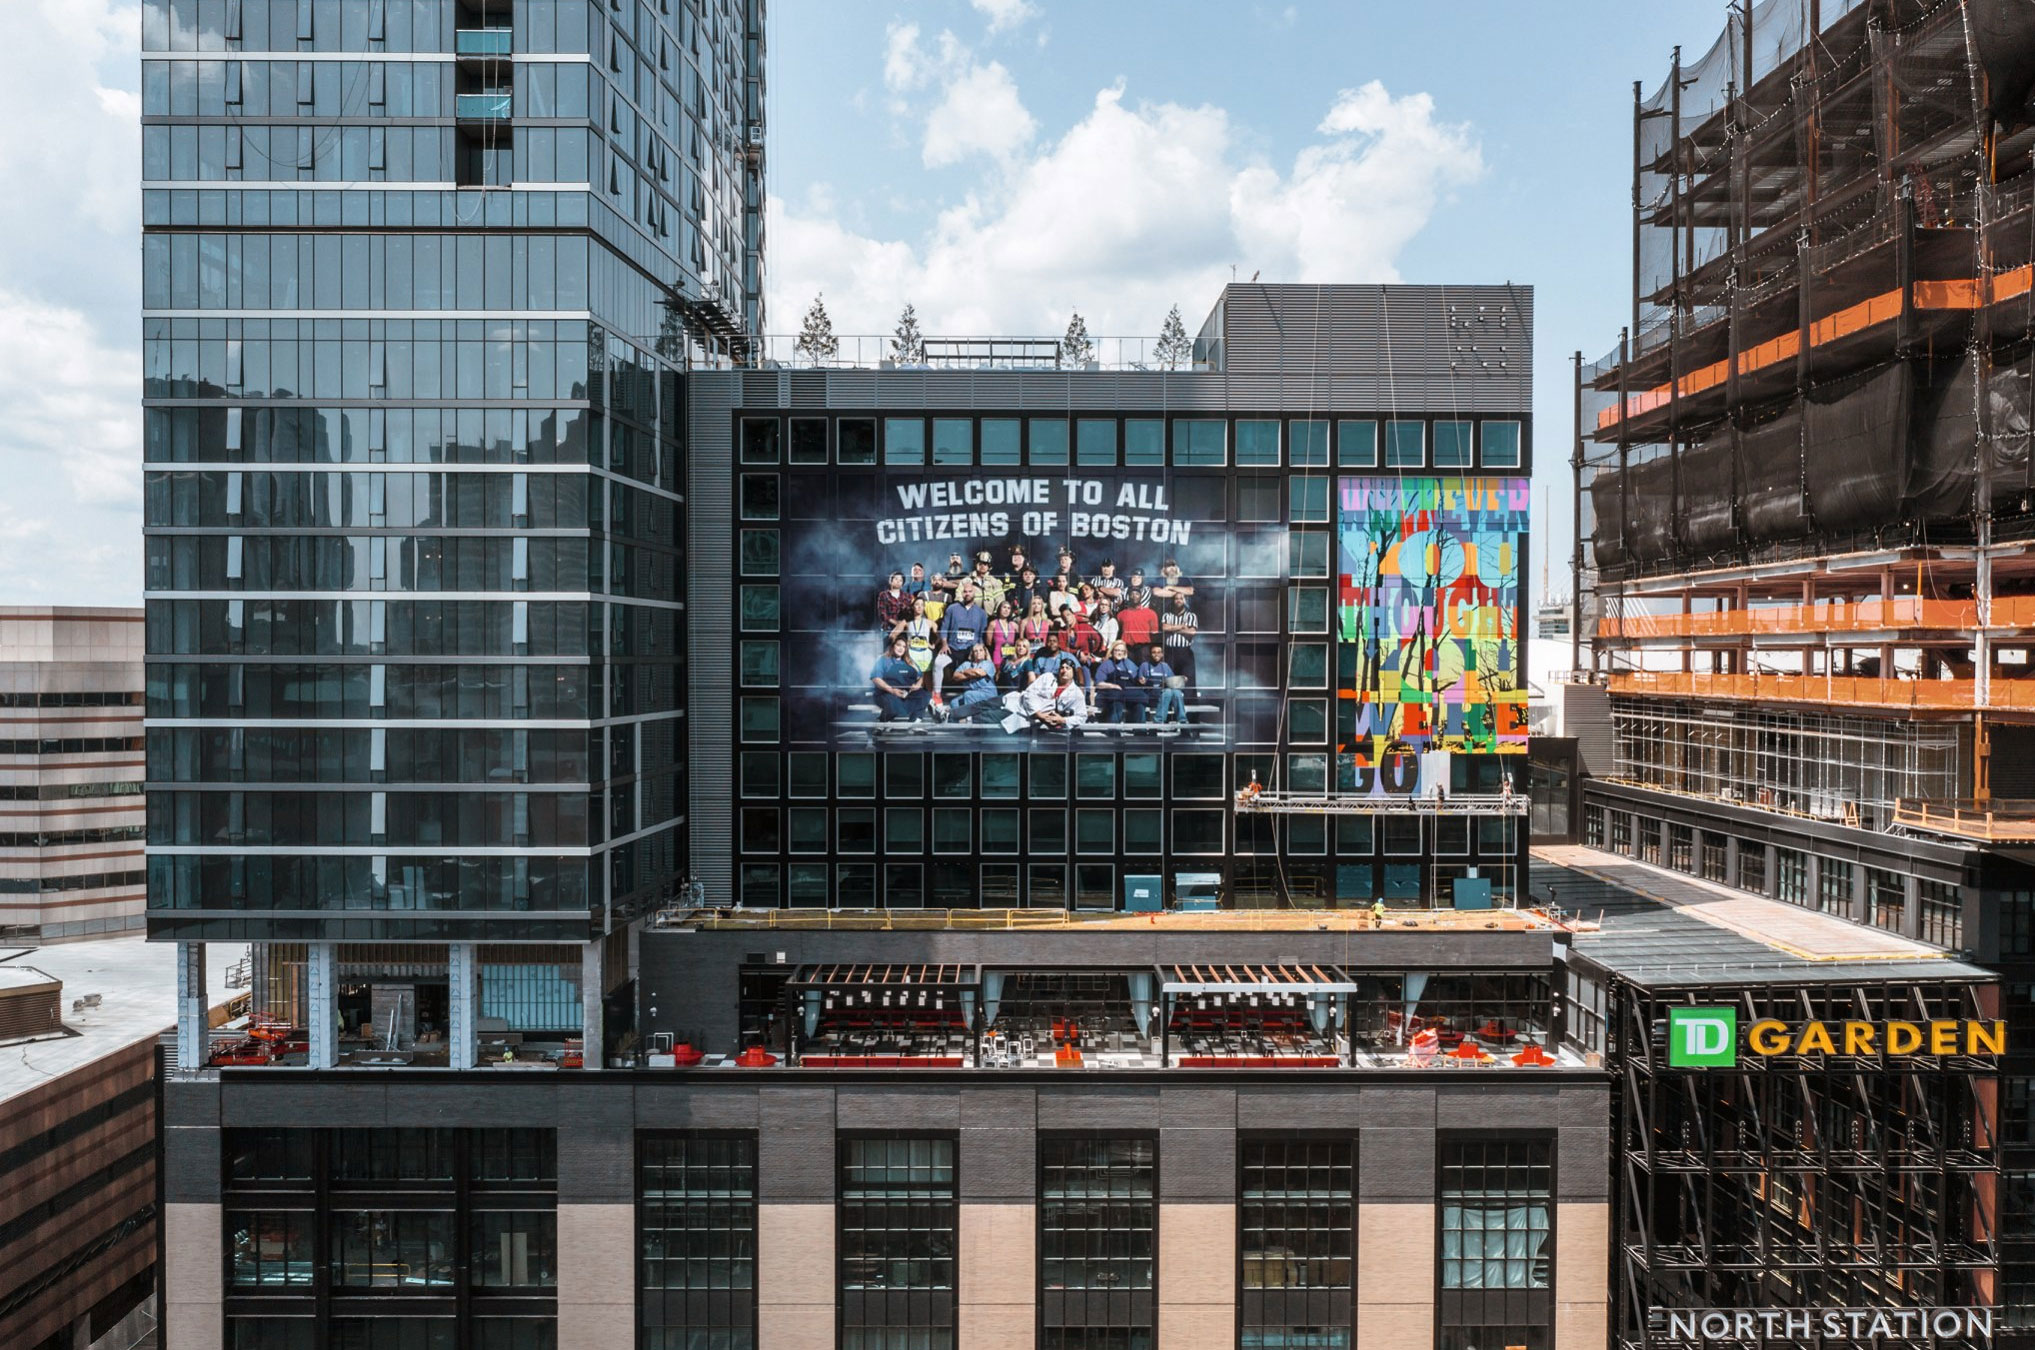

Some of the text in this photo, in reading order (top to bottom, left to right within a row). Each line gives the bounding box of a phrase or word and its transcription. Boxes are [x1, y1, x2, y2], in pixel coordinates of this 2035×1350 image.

[897, 479, 1169, 511] WELCOME TO ALL
[876, 511, 1191, 546] CITIZENS OF BOSTON
[1675, 1018, 2006, 1056] TD GARDEN
[1669, 1310, 1993, 1340] NORTH STATION
